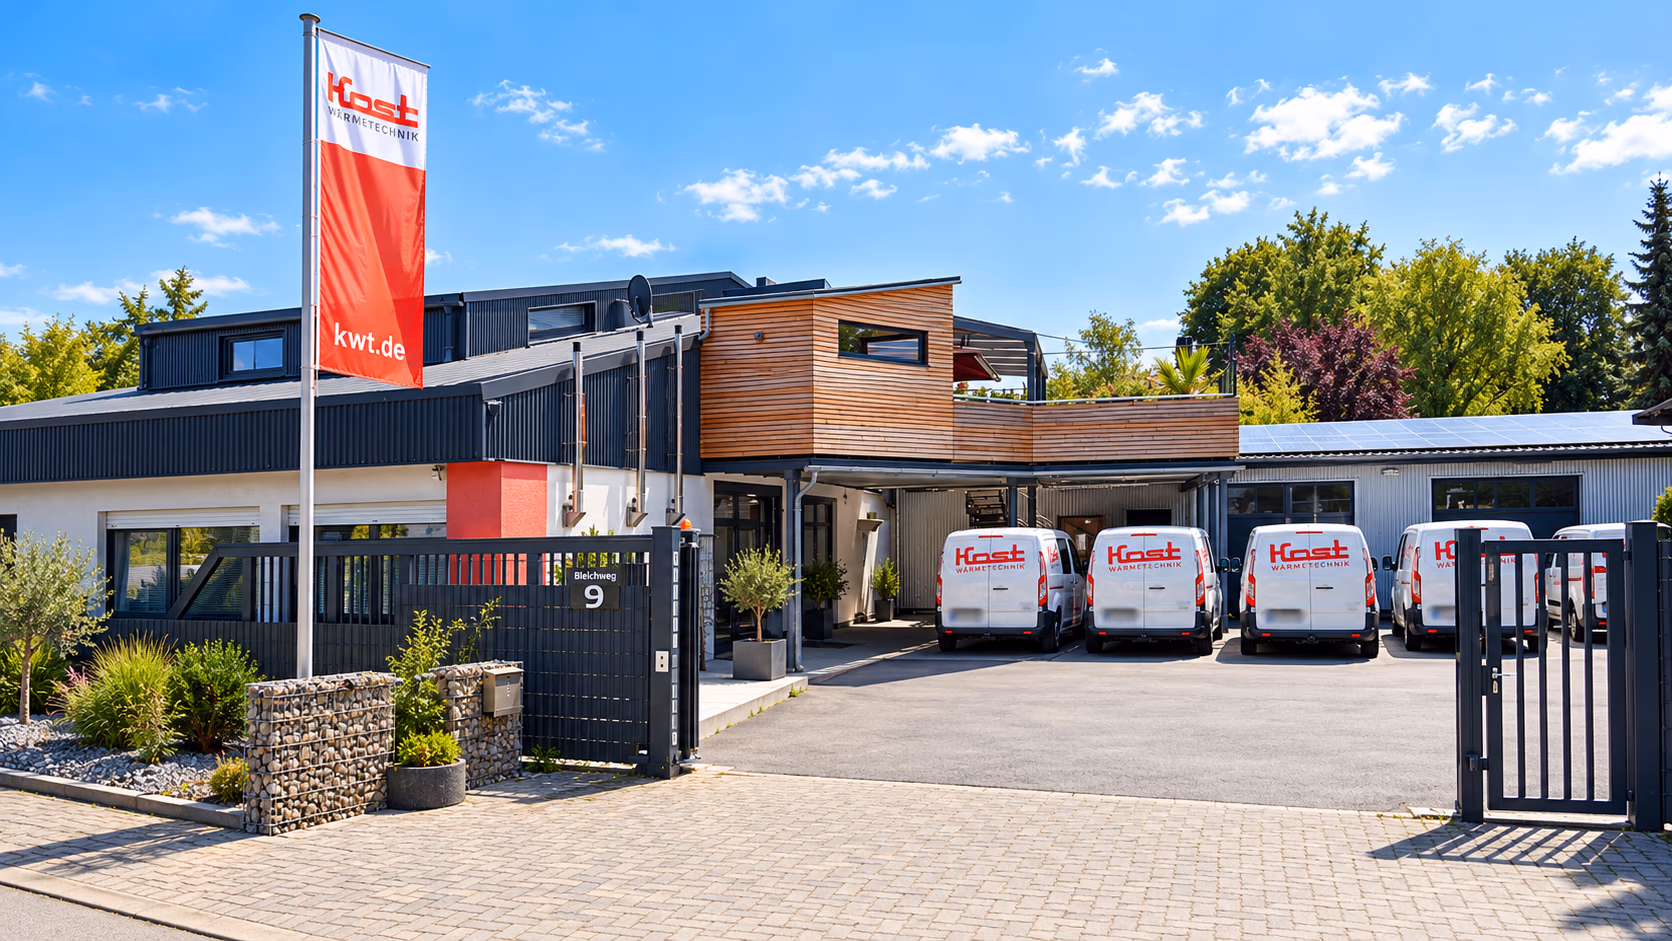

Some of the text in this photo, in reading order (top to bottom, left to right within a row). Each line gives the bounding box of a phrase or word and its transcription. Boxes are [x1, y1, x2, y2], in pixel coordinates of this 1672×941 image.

[328, 105, 419, 142] WÄRMETECHNIK
[334, 322, 406, 361] kwt.de
[574, 571, 617, 582] Bleichweg
[584, 584, 604, 609] 9
